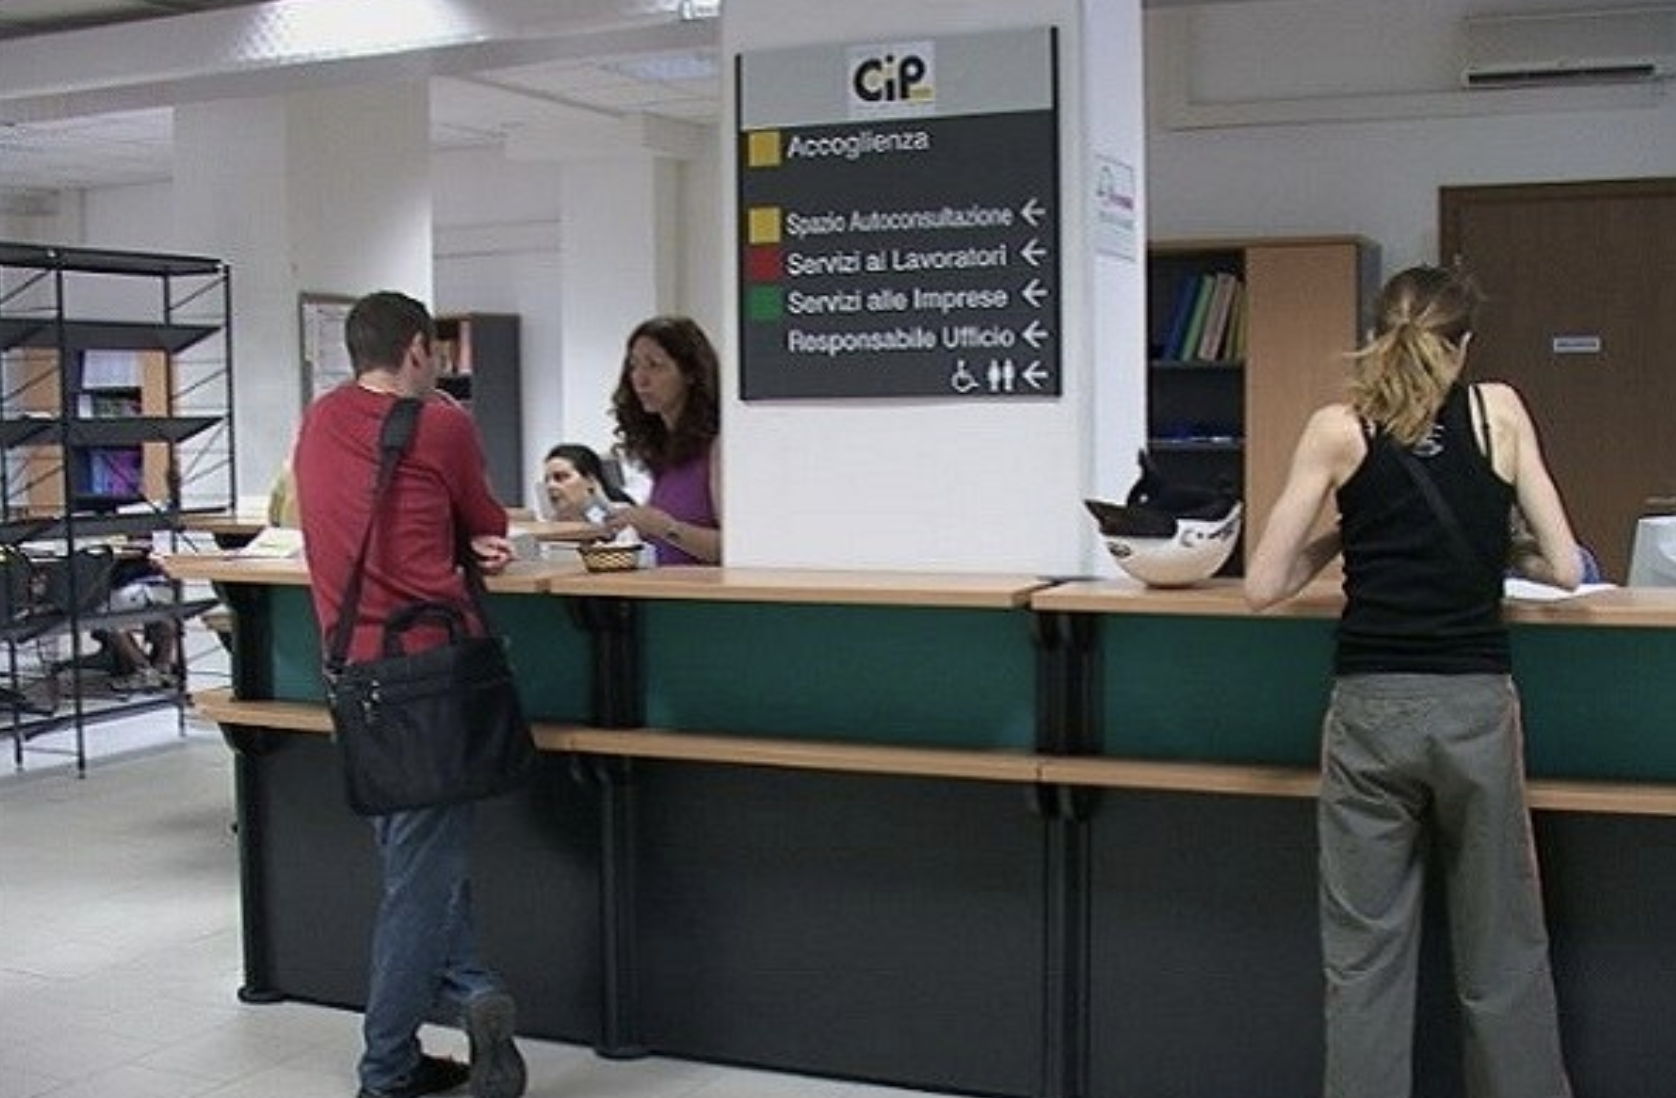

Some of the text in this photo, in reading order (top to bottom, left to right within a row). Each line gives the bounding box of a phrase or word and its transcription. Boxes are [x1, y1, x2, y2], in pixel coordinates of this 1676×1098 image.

[787, 131, 930, 160] Accoglienza
[786, 202, 1013, 239] Spazio Autoconsultazione
[787, 250, 862, 275] Servizi
[892, 243, 1007, 270] Lavoratori
[787, 287, 1010, 314] Servizi alle Imprese
[787, 325, 1016, 356] Responsabile Ufficio
